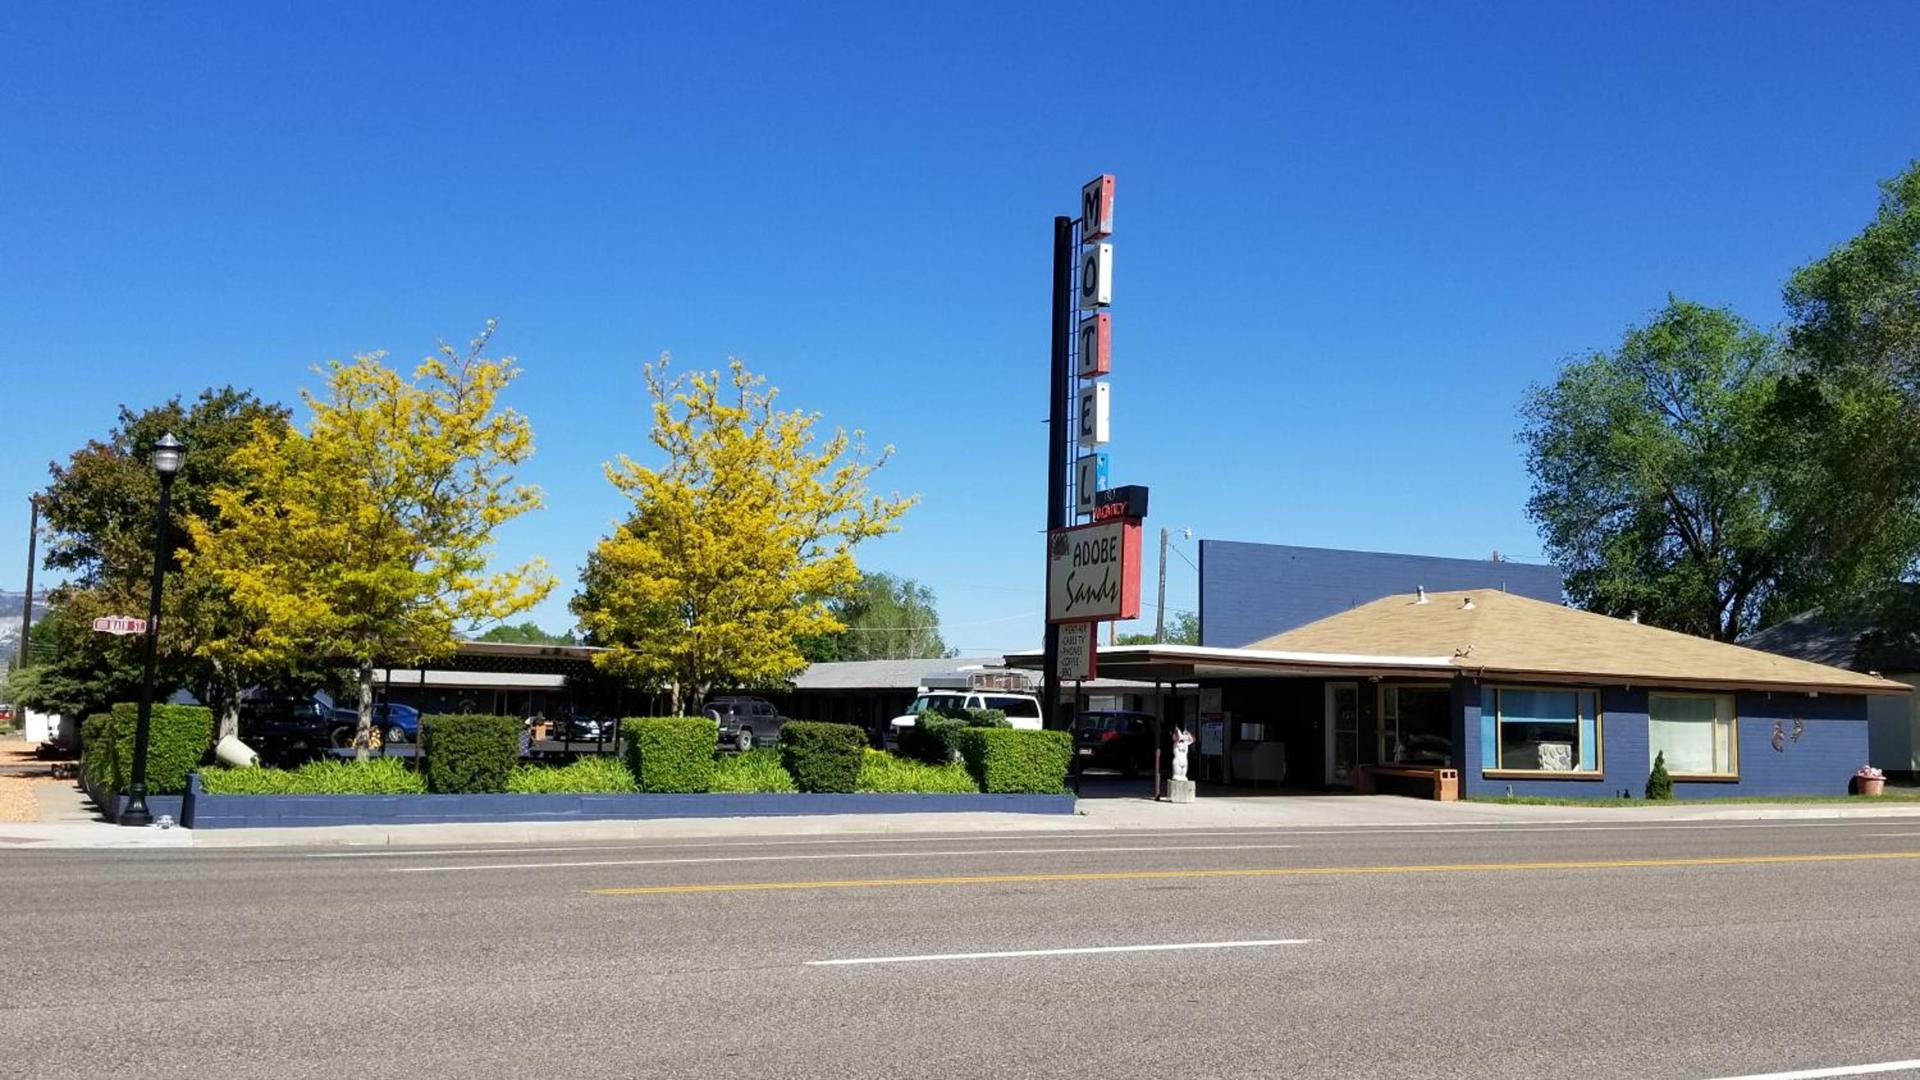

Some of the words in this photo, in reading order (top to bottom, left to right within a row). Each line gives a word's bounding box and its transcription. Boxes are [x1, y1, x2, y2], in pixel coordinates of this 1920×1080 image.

[1081, 187, 1100, 505] MOTEL
[1073, 536, 1117, 567] ADOBE
[1066, 566, 1119, 612] Sands
